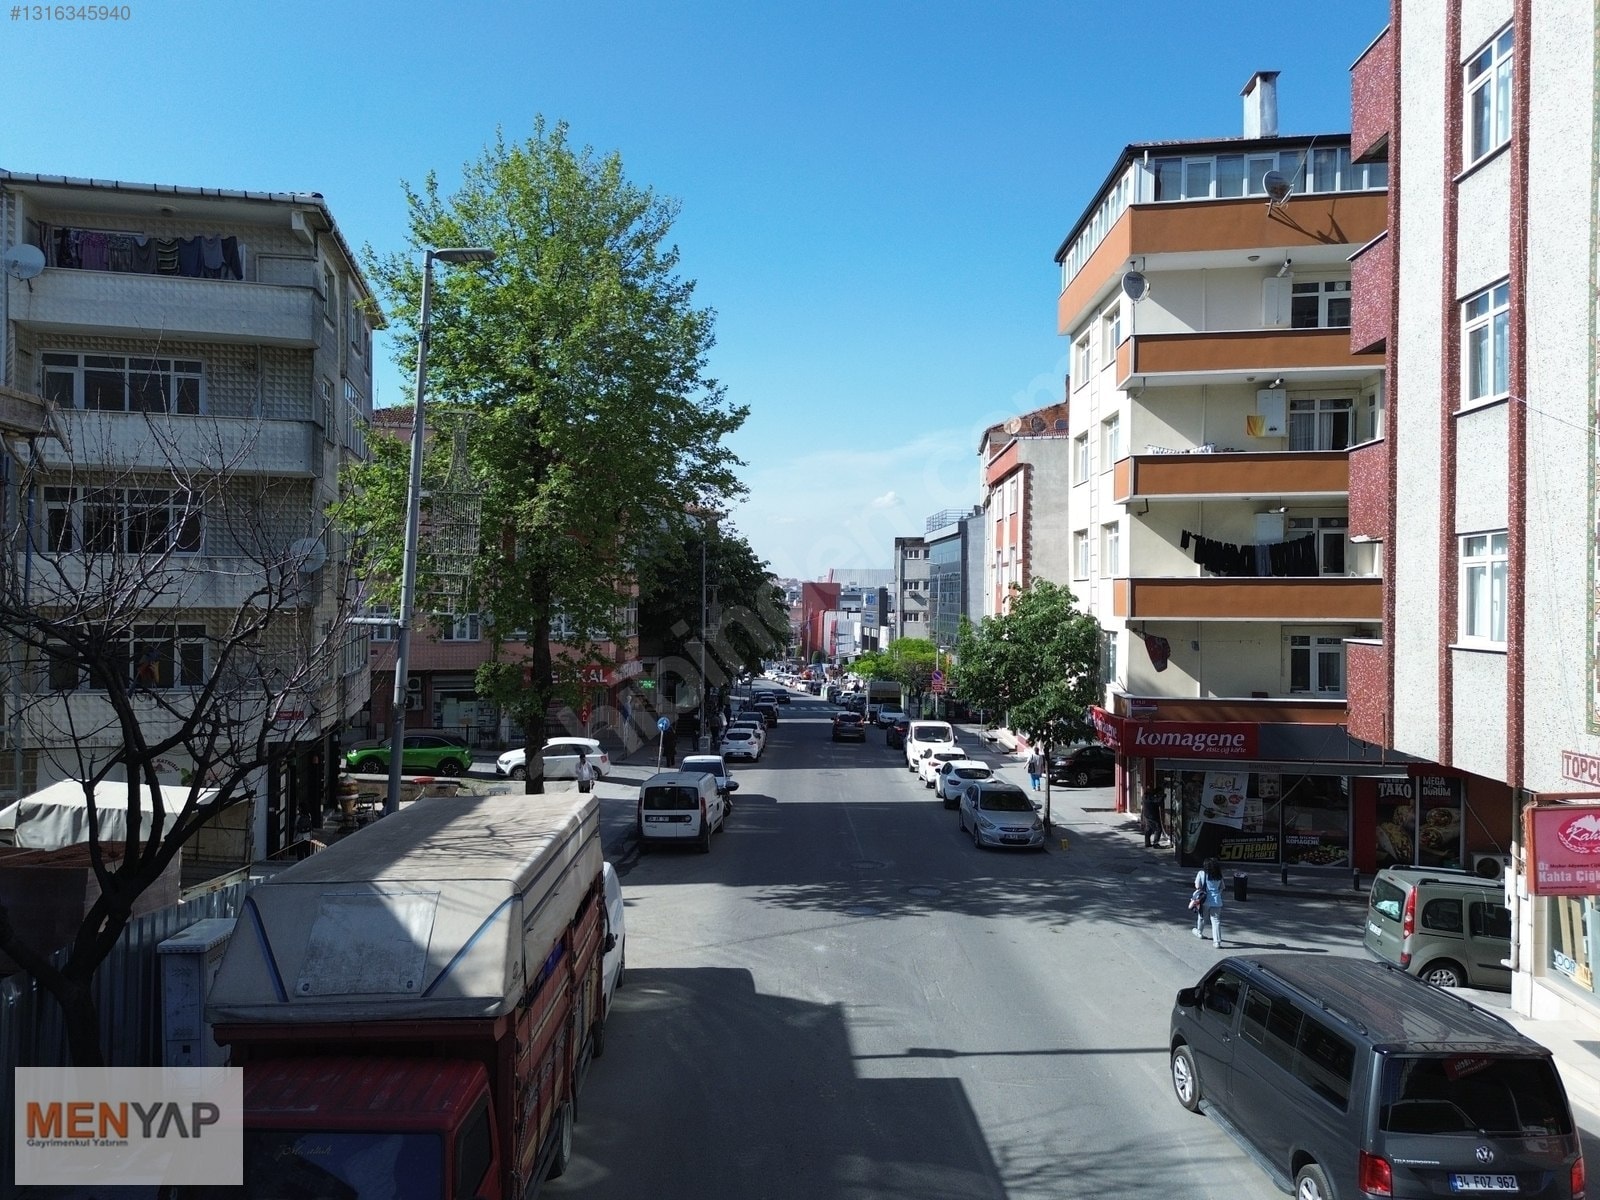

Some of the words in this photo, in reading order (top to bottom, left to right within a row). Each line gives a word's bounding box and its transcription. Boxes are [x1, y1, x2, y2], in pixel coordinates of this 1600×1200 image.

[1135, 727, 1245, 752] komagene
[1422, 776, 1446, 786] MEGA
[1378, 782, 1412, 798] TAKO
[1539, 870, 1572, 882] Kahta
[1457, 1175, 1470, 1188] 34
[1497, 1175, 1516, 1189] 962
